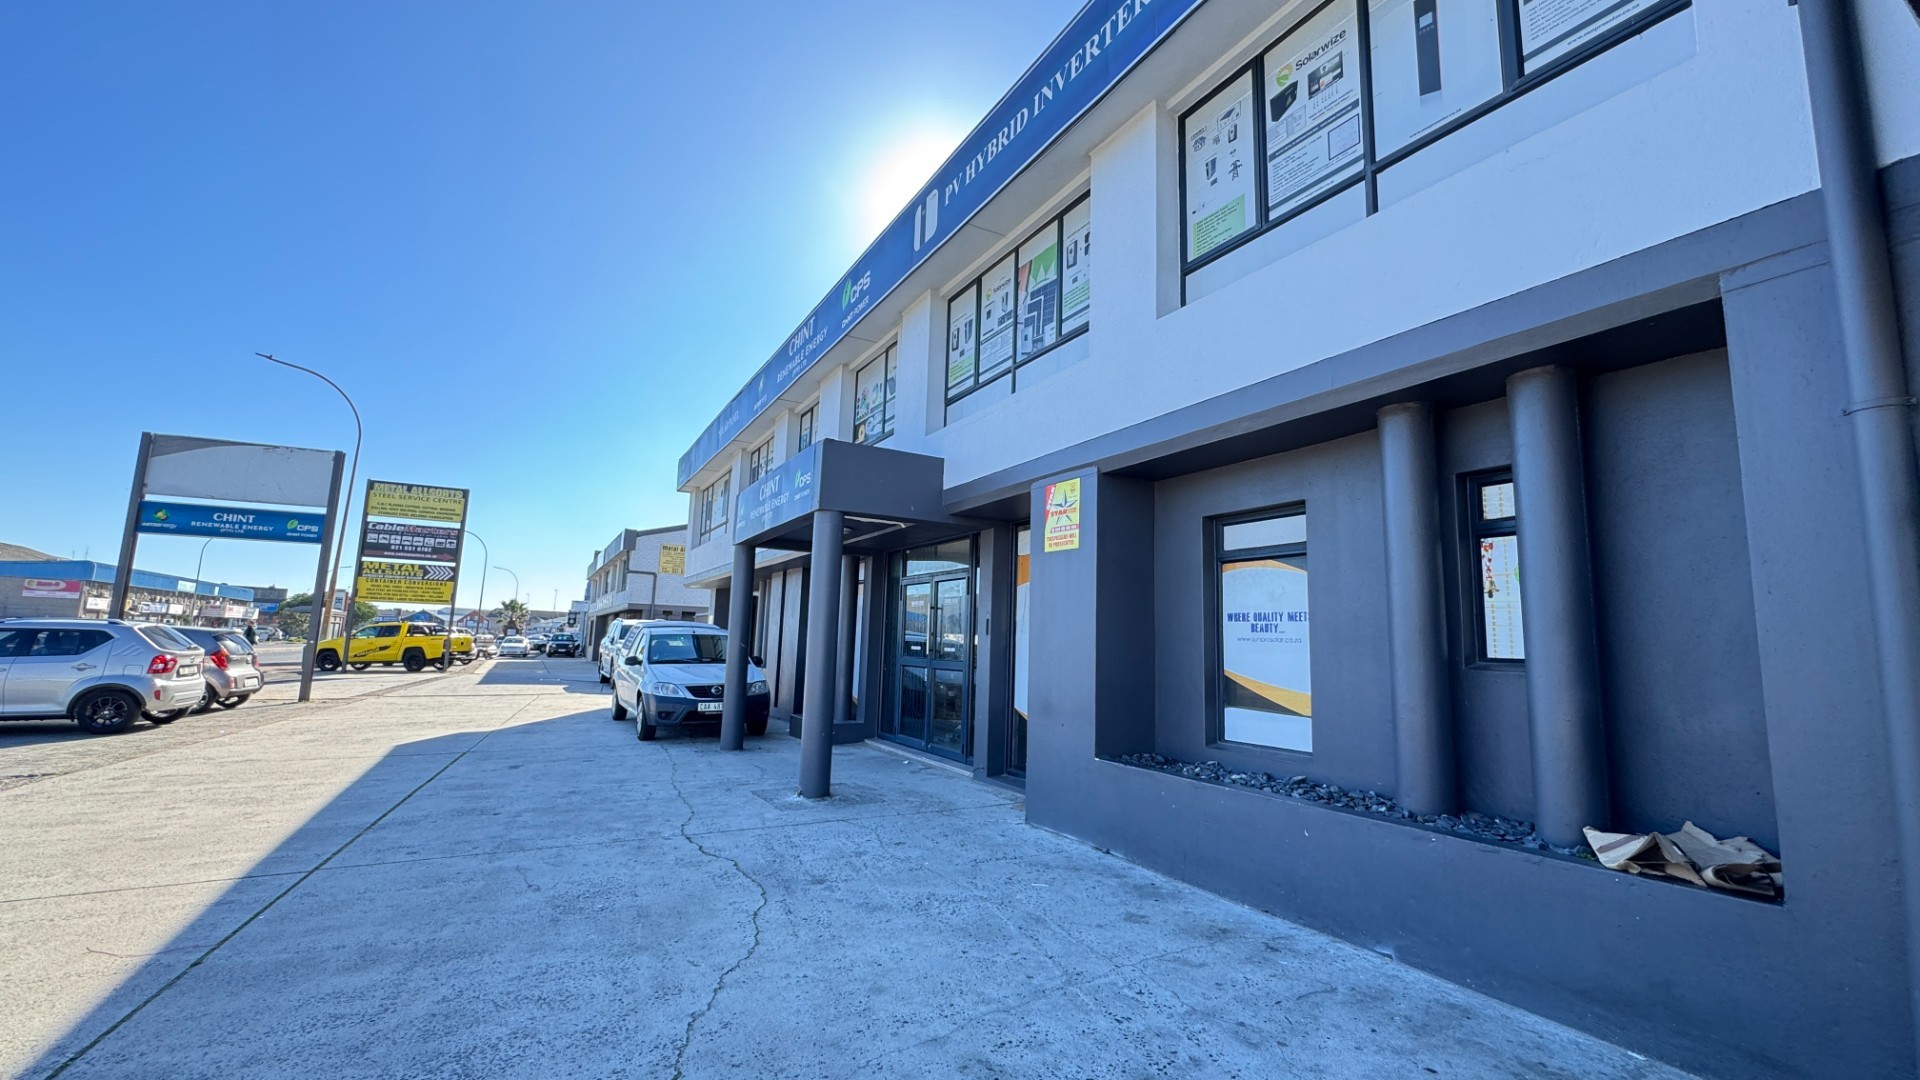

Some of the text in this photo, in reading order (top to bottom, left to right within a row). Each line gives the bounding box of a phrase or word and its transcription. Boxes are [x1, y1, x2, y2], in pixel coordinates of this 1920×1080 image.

[1295, 29, 1347, 71] Solarwize
[944, 172, 963, 207] PV
[964, 107, 1028, 186] HYBRID
[850, 270, 871, 304] CPS
[788, 316, 816, 356] CHINT
[806, 325, 828, 356] ENERGY
[760, 474, 780, 501] CHINT
[800, 472, 812, 488] CPS
[374, 482, 464, 499] METAL ALLSORTS
[398, 494, 430, 502] SERVICE
[432, 497, 462, 505] CENTRE
[191, 520, 240, 529] RENEWABLE
[213, 512, 256, 523] CHINT
[363, 561, 422, 572] METAL
[1227, 611, 1310, 622] WHERE QUALITY MEET
